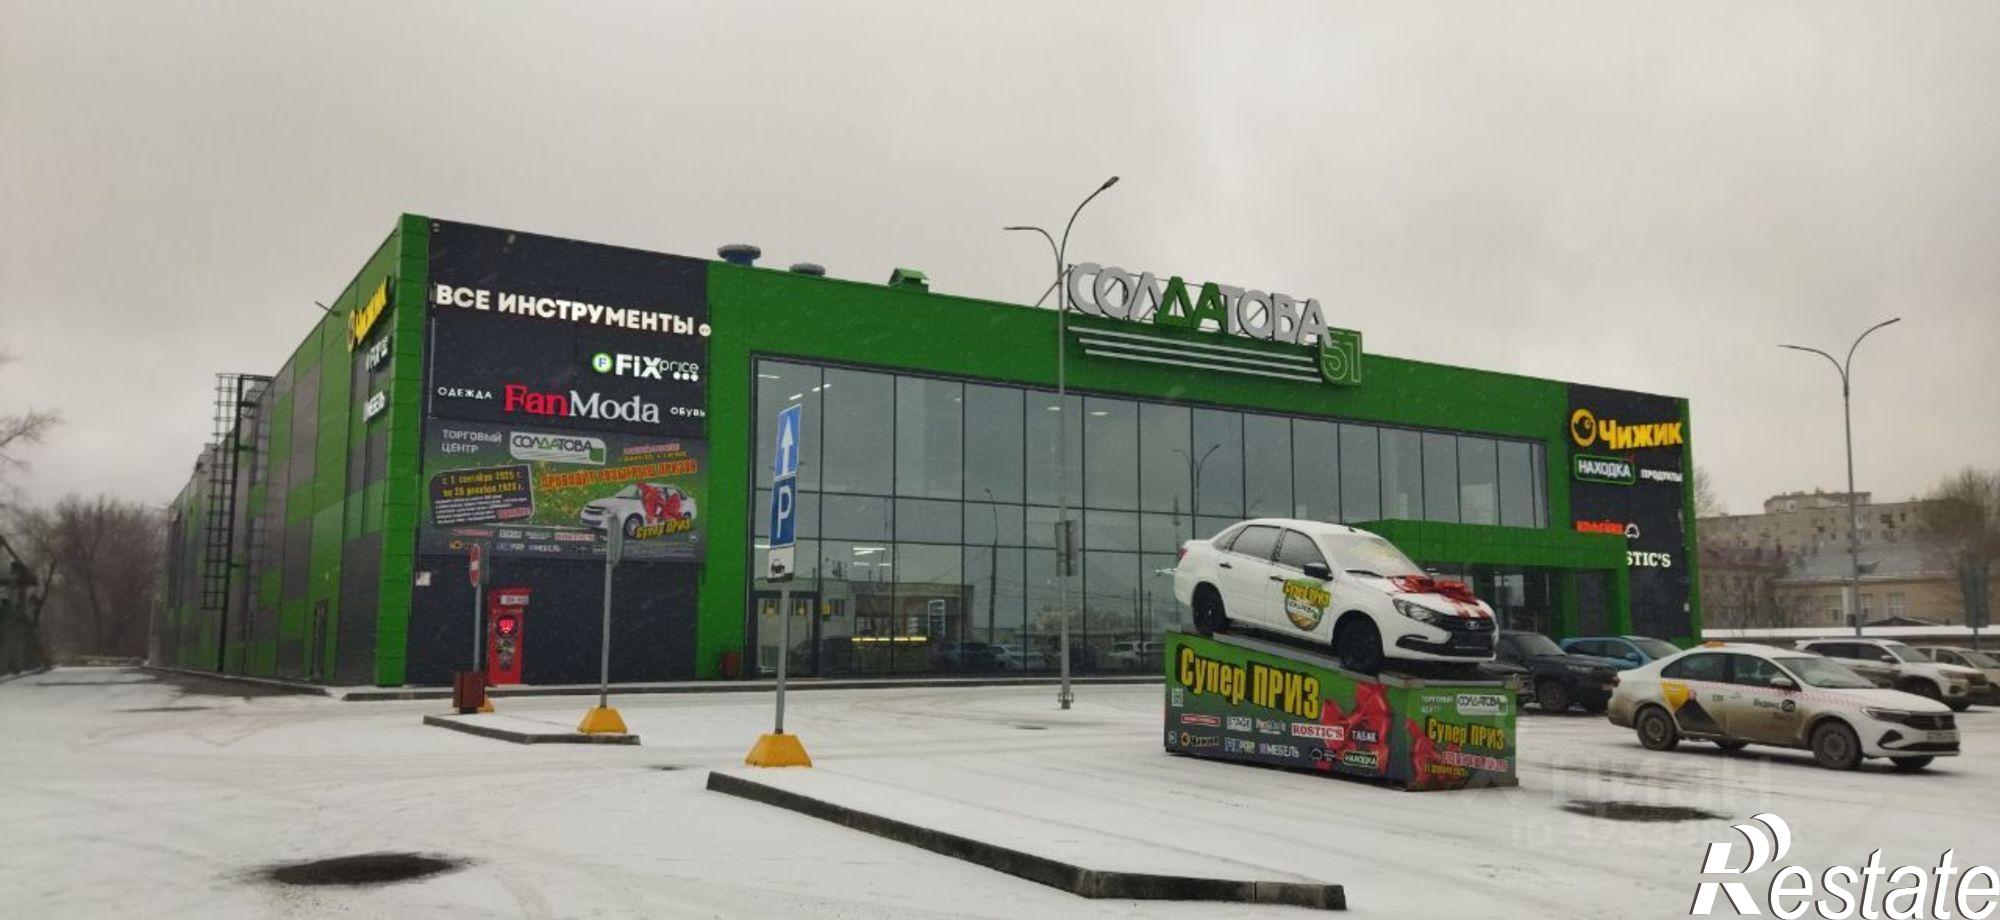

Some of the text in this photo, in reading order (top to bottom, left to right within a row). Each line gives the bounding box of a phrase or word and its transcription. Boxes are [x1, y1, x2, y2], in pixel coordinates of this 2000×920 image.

[435, 283, 694, 336] ВСЕ ИНСТРУМЕНТЫ
[1068, 262, 1334, 348] СОЛДАТОВА
[437, 386, 492, 400] ОДЕЖДА
[504, 384, 660, 424] FanModa
[670, 406, 706, 418] ОБУВЬ
[441, 429, 502, 443] ТОРГОВЫЙ
[512, 435, 593, 453] СОЛДАТОВА
[441, 443, 479, 454] ЦЕНТР
[1578, 460, 1632, 478] НАХОДКА
[1640, 469, 1683, 482] ПРОДУКТЫ
[777, 485, 792, 539] P
[1627, 551, 1672, 568] STIC'S
[1181, 648, 1320, 719] Супер ПРИЗ
[1293, 725, 1343, 740] ROSTIC'S
[1428, 718, 1505, 750] Супер ПРИЗ
[1267, 744, 1300, 759] МЕБЕЛЬ
